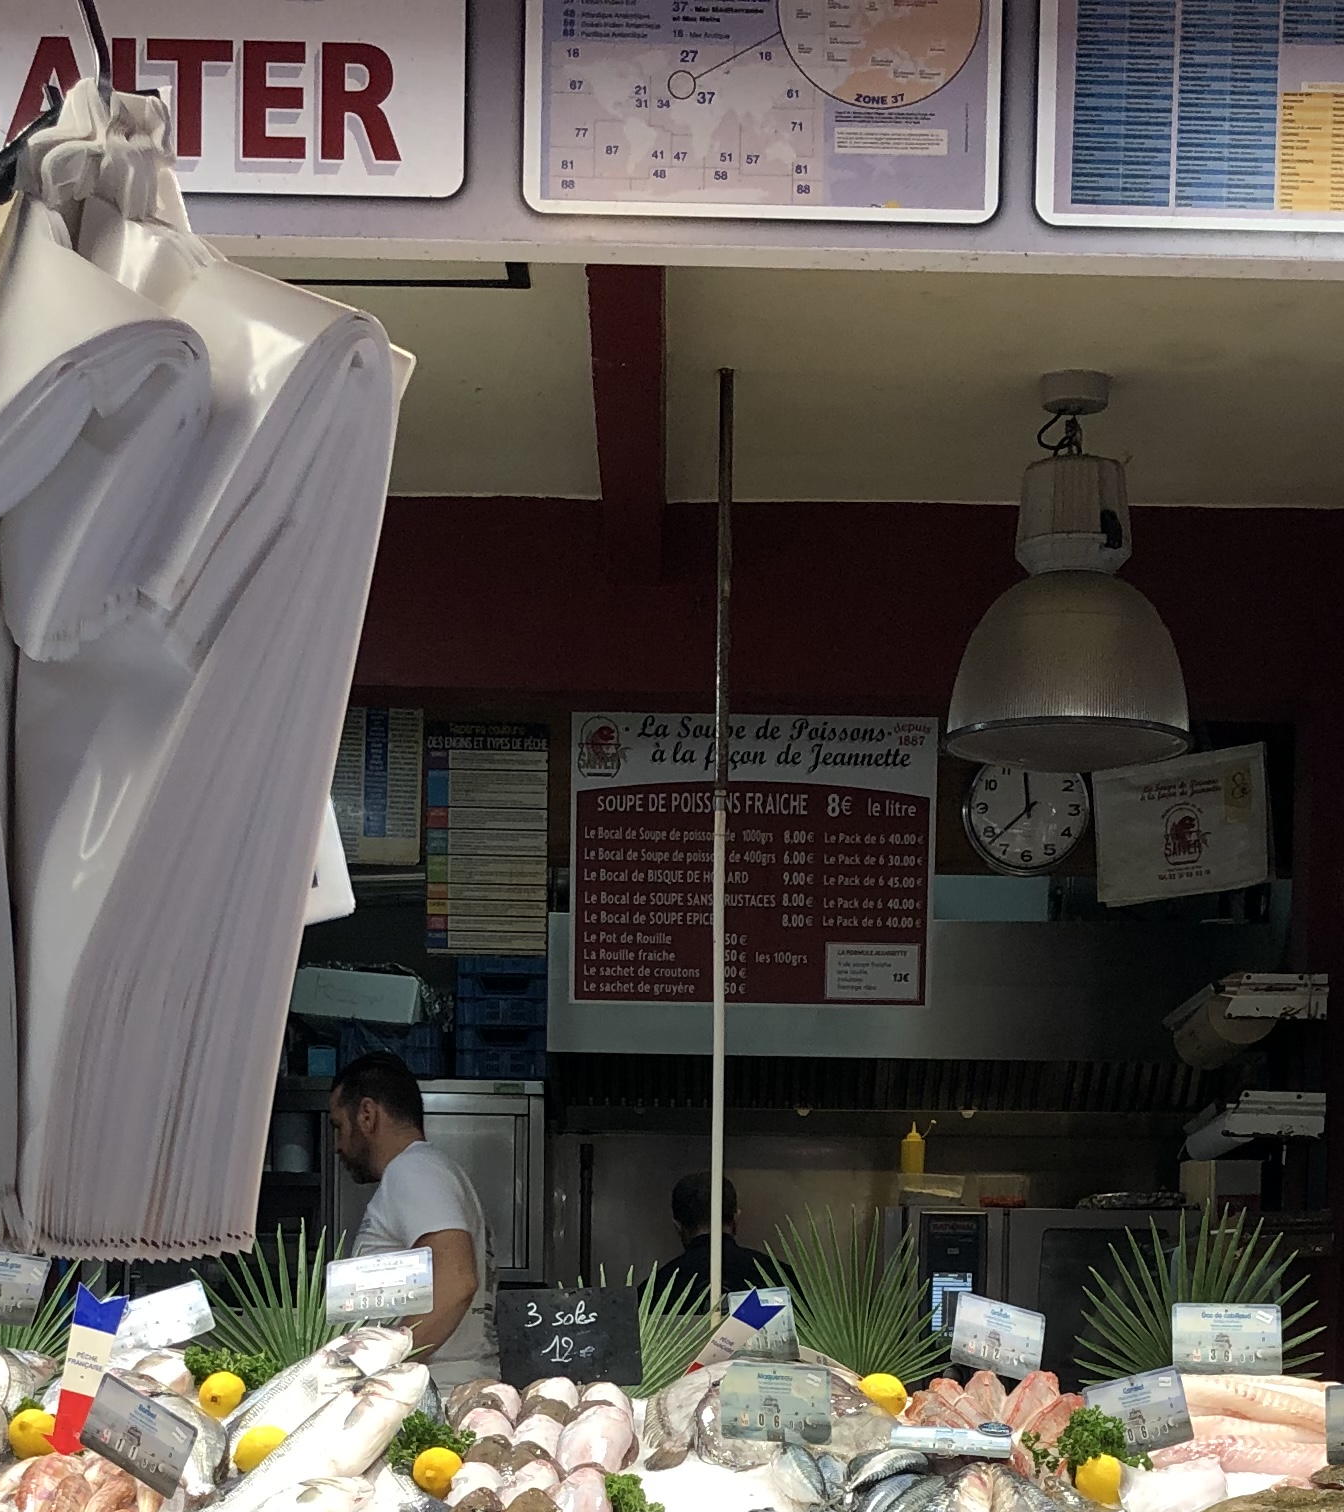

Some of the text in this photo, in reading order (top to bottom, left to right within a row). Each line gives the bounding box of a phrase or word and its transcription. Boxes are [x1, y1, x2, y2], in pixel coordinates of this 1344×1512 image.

[854, 93, 905, 104] ZONE 37
[575, 128, 588, 137] 77
[791, 122, 803, 131] 71
[652, 151, 664, 159] 41
[674, 152, 687, 161] 47
[720, 153, 733, 162] 51
[746, 155, 760, 164] 57
[638, 715, 670, 738] La
[755, 717, 781, 740] de
[789, 718, 886, 742] Poissons
[893, 722, 932, 736] depuis
[427, 736, 548, 751] DES ENGINS ET TYPES DE PÊCHE
[898, 736, 925, 747] 1887
[651, 742, 911, 773] à la fçon de Jeannette
[984, 779, 998, 791] 10
[1062, 780, 1074, 791] 2
[597, 794, 644, 813] SOUPE
[648, 794, 667, 813] DE
[746, 793, 808, 815] FRAICHE
[827, 793, 853, 818] 8€
[868, 798, 883, 816] le
[885, 798, 917, 818] litre
[976, 802, 988, 815] 9
[1068, 804, 1080, 816] 3
[1061, 826, 1072, 838] 4
[1021, 850, 1032, 862] 6
[1044, 844, 1056, 856] 5
[744, 850, 776, 866] 400grs
[783, 852, 814, 865] 6.00€
[584, 868, 700, 885] Le Bocal de BISQUE DE
[783, 872, 814, 885] 9.00€
[824, 875, 835, 886] Le
[837, 875, 861, 887] Pack
[863, 876, 876, 887] de
[878, 877, 885, 887] 6
[584, 932, 672, 945] Le Pot de Rouille
[584, 949, 597, 961] La
[599, 949, 635, 961] Rouille
[755, 952, 808, 968] les 100grs
[584, 965, 700, 978] Le sachet de croutons
[524, 1300, 598, 1327] 3 soles
[1214, 1311, 1222, 1319] de
